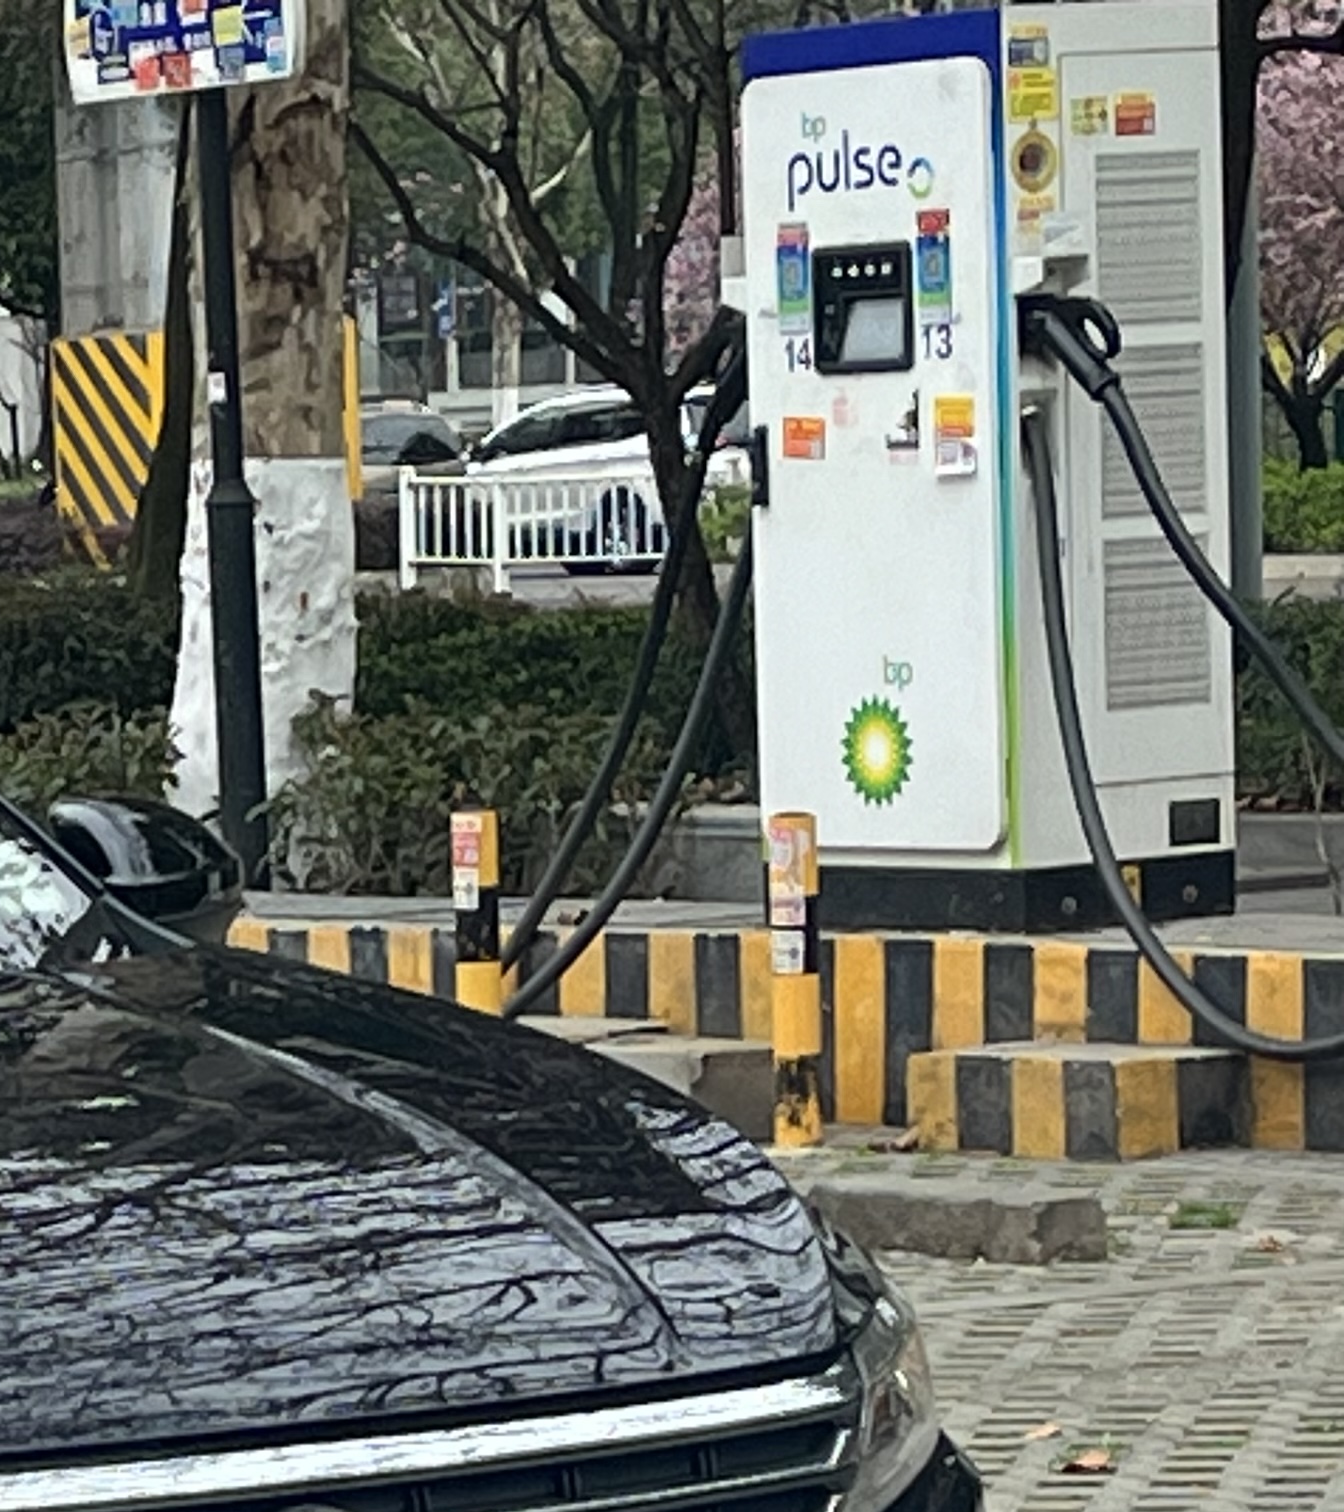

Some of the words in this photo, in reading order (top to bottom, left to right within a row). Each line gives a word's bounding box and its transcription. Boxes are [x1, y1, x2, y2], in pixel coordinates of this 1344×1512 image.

[801, 112, 826, 142] bp
[787, 129, 902, 212] pulse
[785, 338, 812, 372] 14
[922, 325, 953, 360] 13
[882, 654, 914, 692] bp
